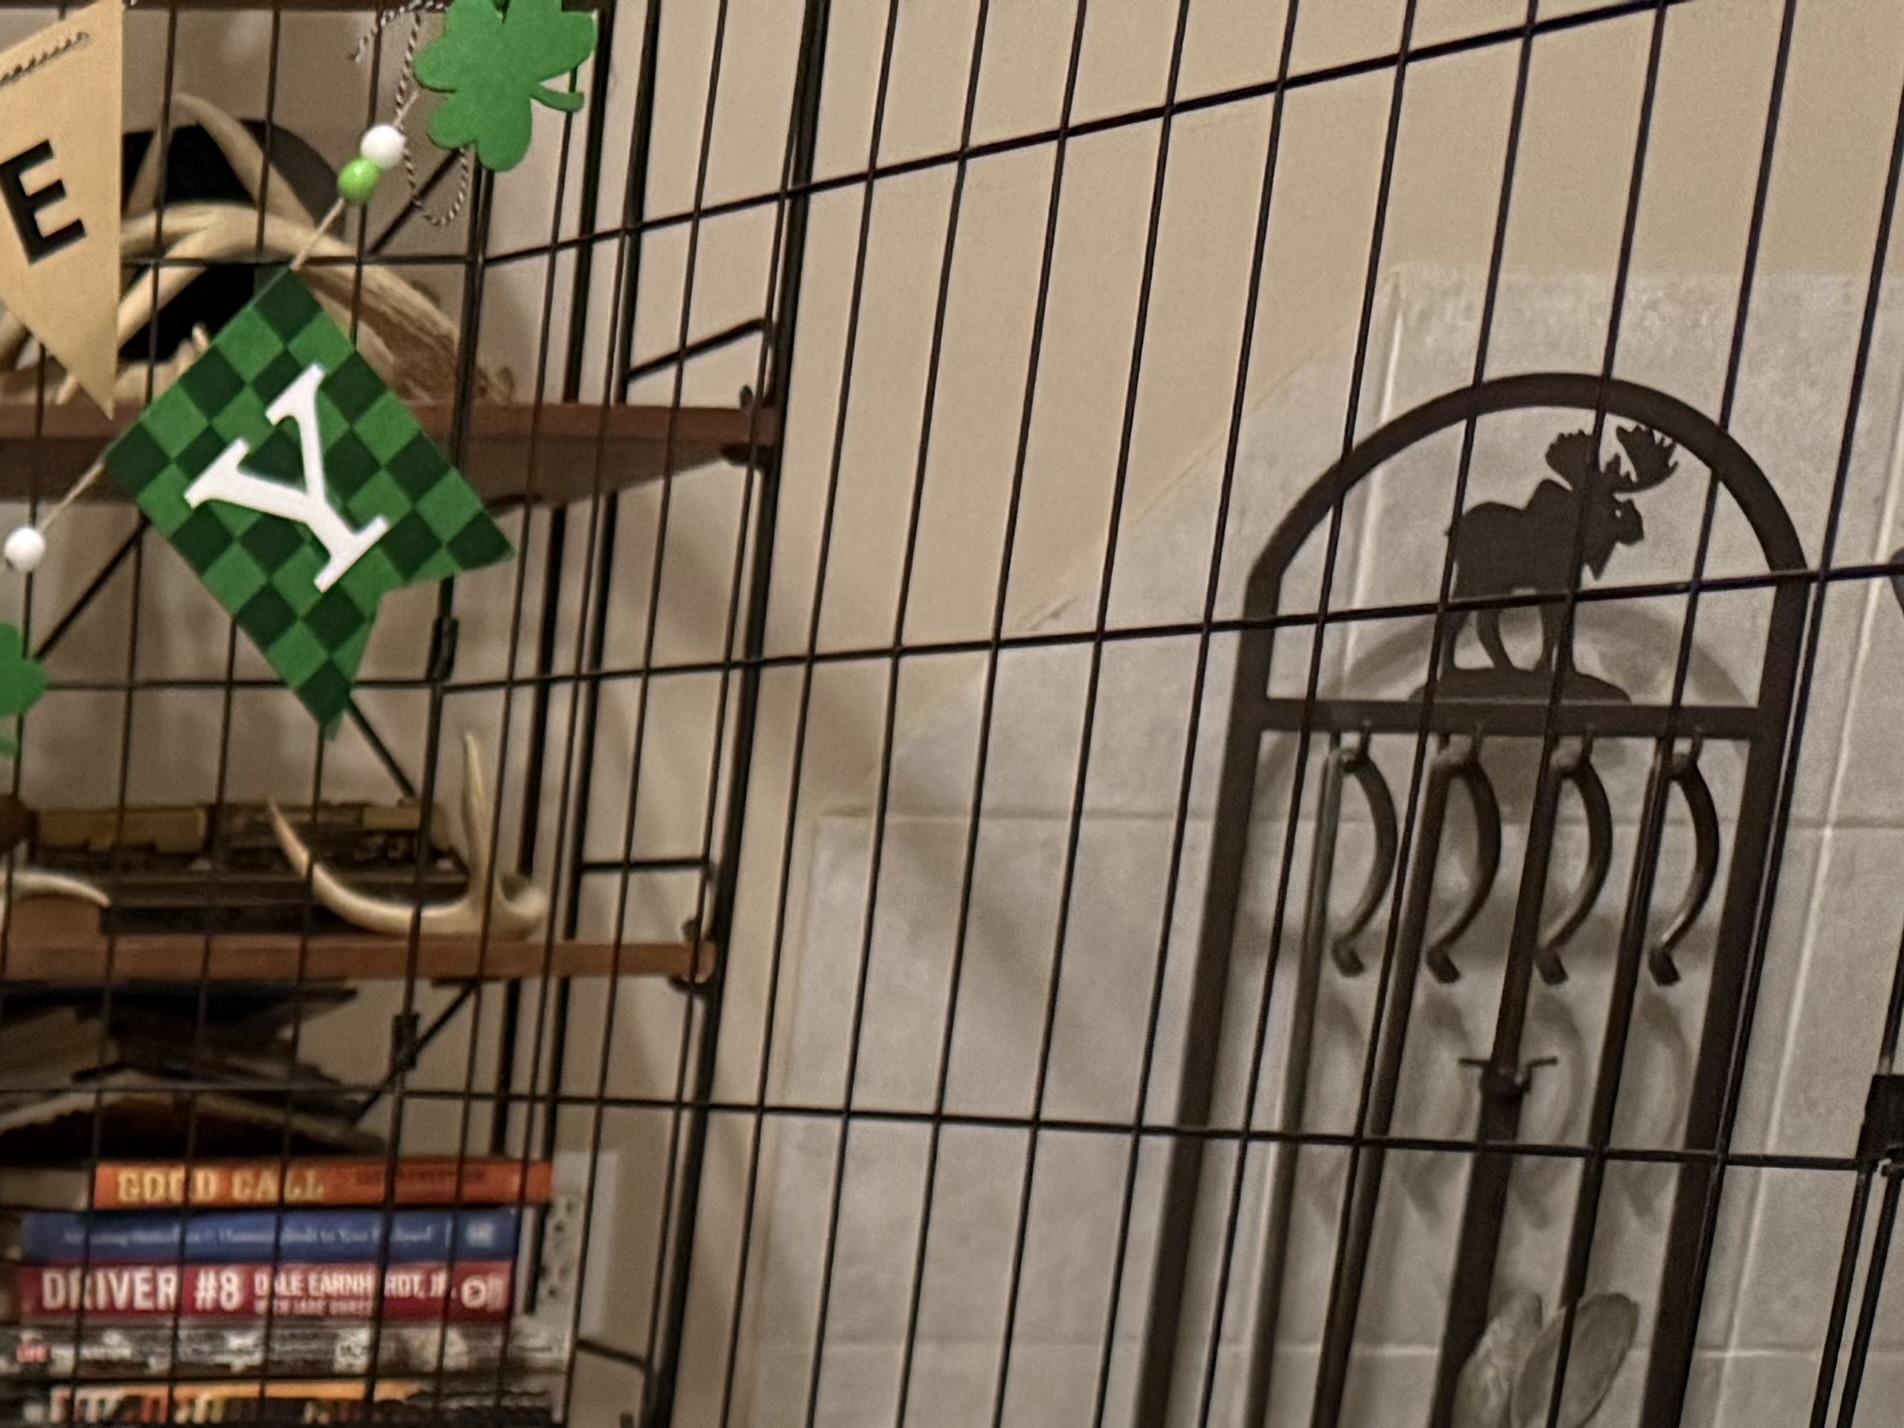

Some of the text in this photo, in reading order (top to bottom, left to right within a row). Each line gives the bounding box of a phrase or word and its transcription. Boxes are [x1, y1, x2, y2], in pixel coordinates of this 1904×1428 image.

[117, 1167, 218, 1202] GOOD
[232, 1166, 325, 1201] CALL
[42, 1265, 242, 1311] DRIVER #8
[308, 1269, 424, 1299] EARNHRDT,
